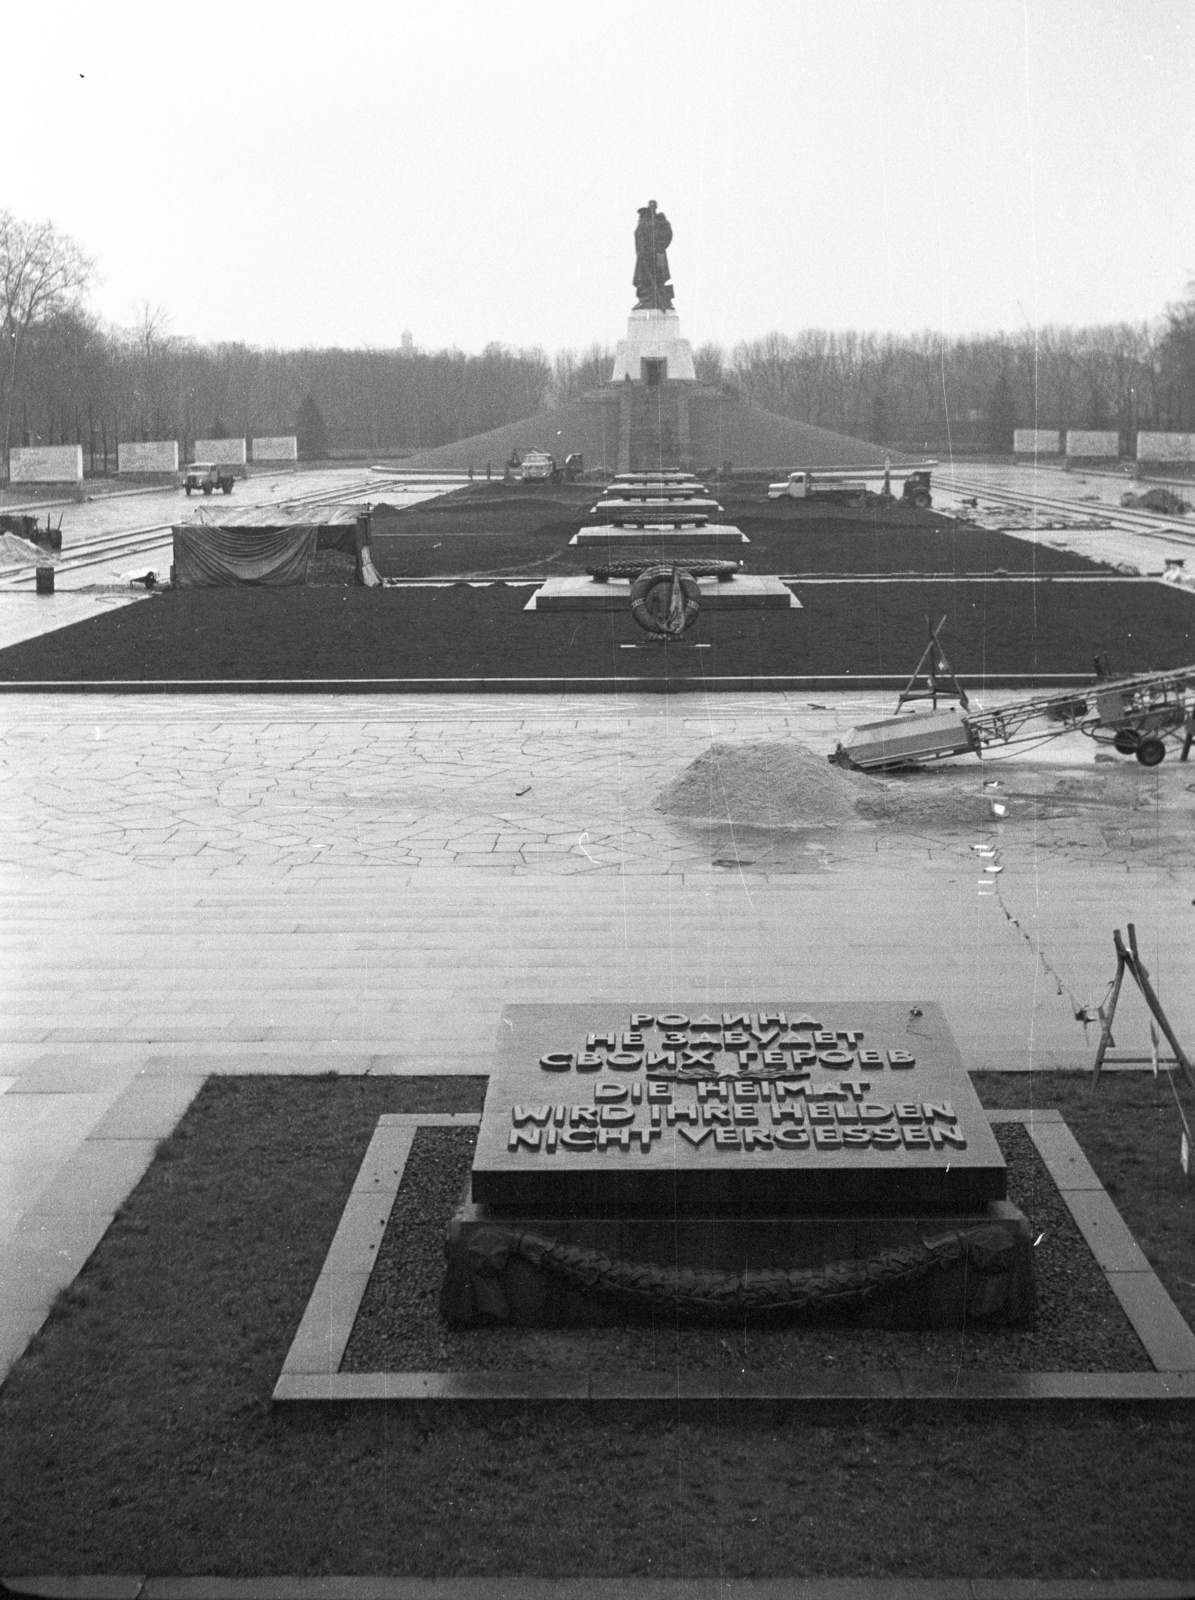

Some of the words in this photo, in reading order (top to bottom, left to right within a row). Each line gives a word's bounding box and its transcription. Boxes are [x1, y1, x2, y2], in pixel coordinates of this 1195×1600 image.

[630, 1012, 823, 1031] РОДИНА
[586, 1031, 645, 1050] НЕ
[661, 1030, 864, 1050] ЗАБУДЕТ
[539, 1050, 714, 1071] СВОИХ
[736, 1049, 916, 1070] ГЕРОЕВ
[594, 1081, 672, 1104] DIE
[697, 1081, 871, 1103] HEIMAT
[512, 1104, 635, 1127] WIRD
[650, 1103, 758, 1125] IHRE
[771, 1102, 957, 1124] HELDEN
[507, 1127, 661, 1153] NICHT
[678, 1126, 967, 1150] VERGESSEN
